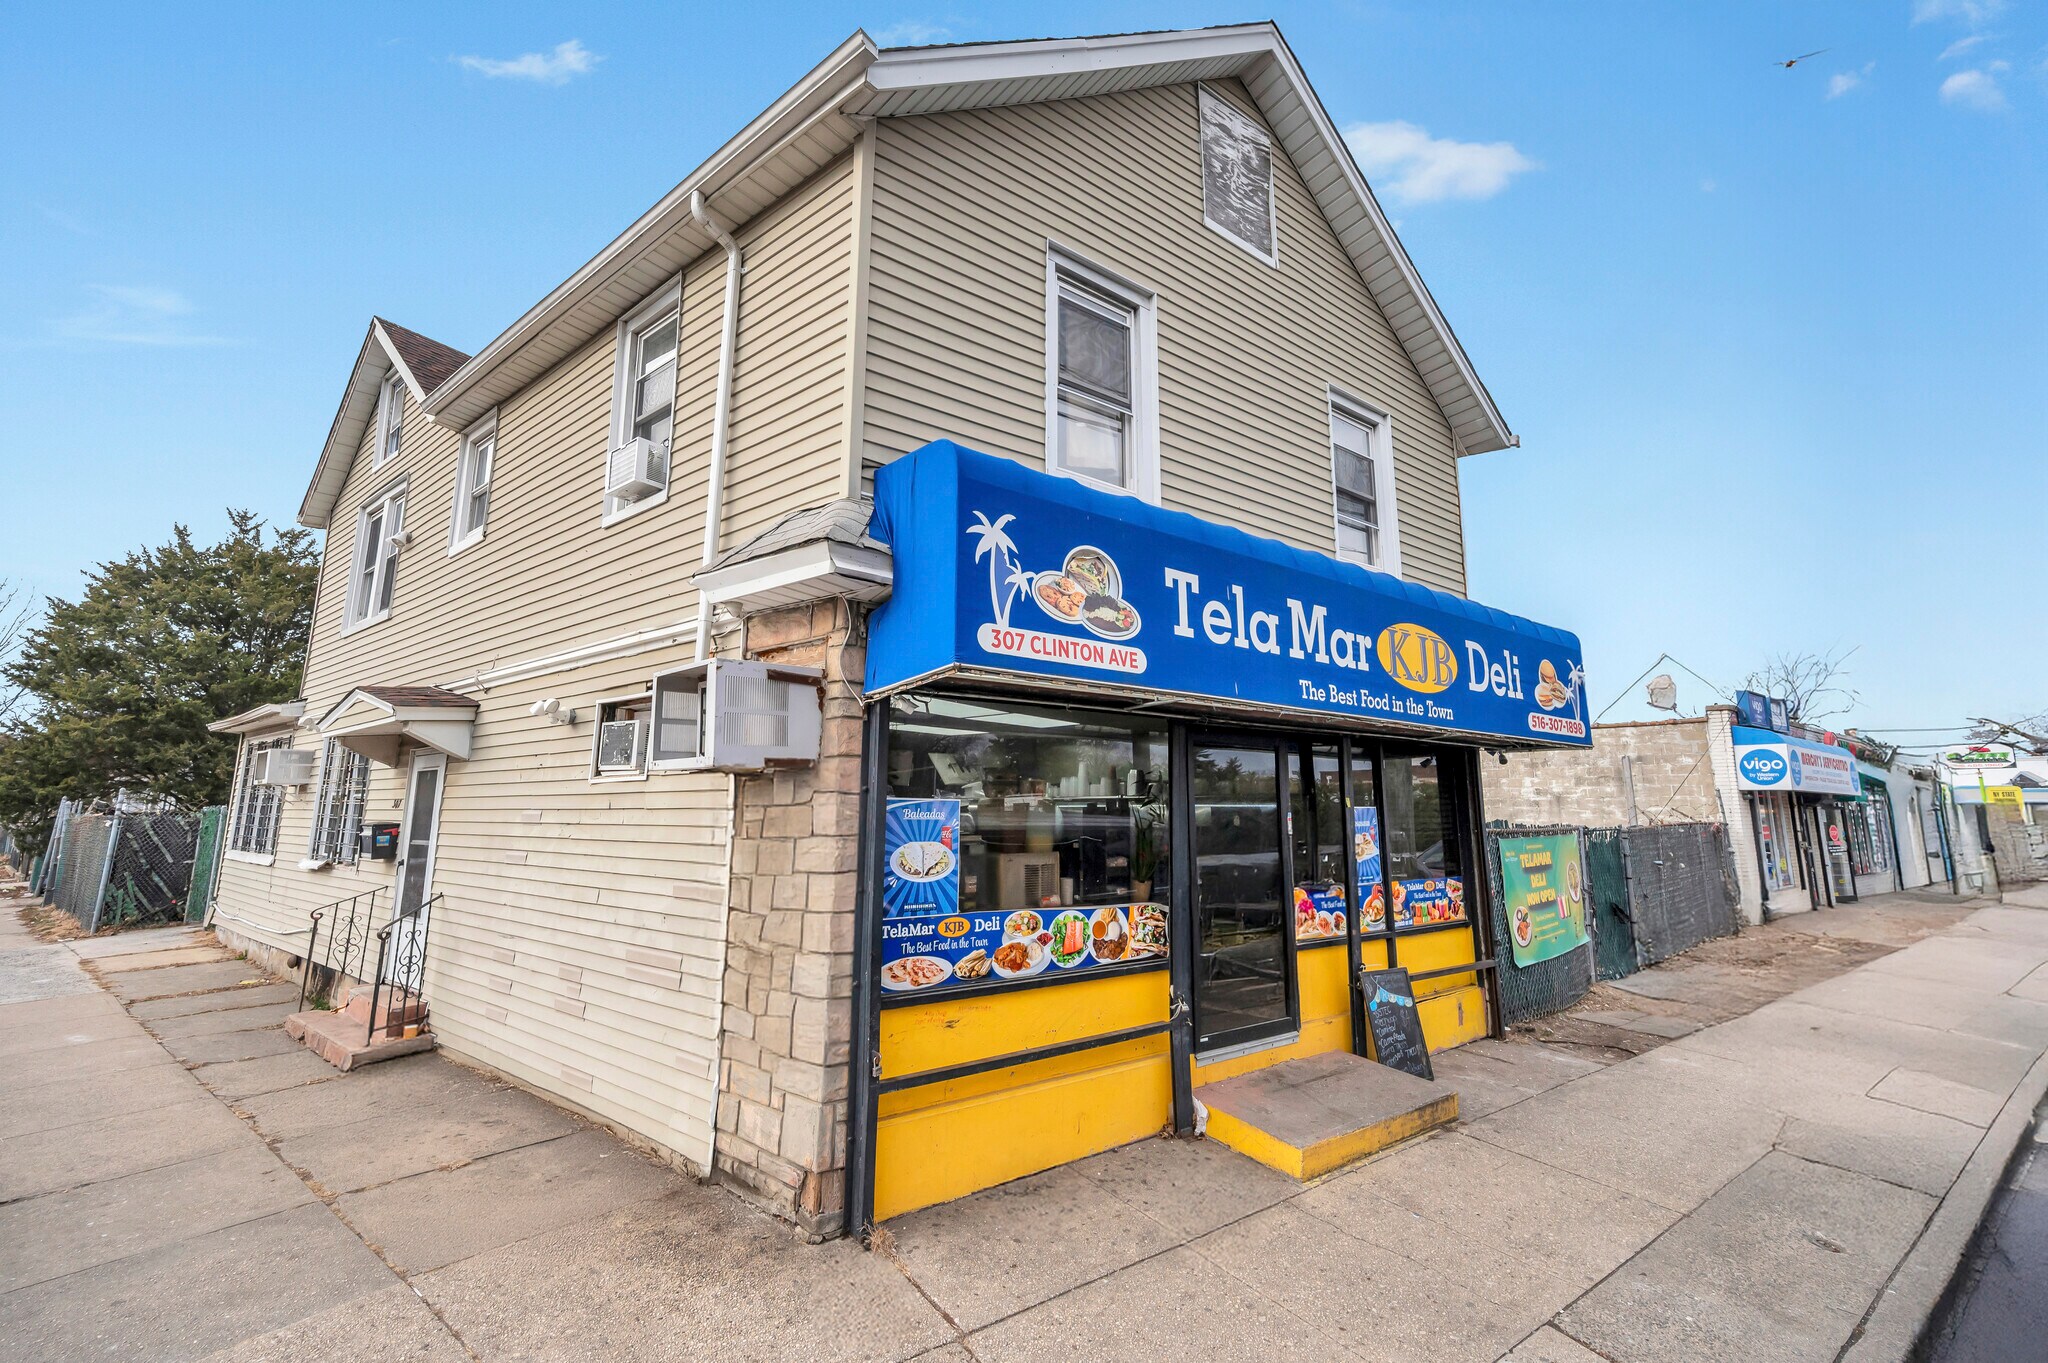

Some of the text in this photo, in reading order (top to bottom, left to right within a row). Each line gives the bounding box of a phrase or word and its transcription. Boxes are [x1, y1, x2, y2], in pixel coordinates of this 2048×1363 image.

[1165, 567, 1524, 699] Tela Mar KJB Deli
[991, 629, 1139, 669] 307 CLINTON AVE
[1299, 679, 1454, 720] The Best Food in the Town
[1531, 715, 1583, 735] 516-307-1898
[1743, 757, 1783, 772] vigo
[903, 808, 945, 820] Baleadas
[1520, 852, 1552, 868] TELAMAR
[1530, 873, 1546, 888] DELI
[882, 916, 1001, 939] TelaMar KJB Deli
[901, 936, 989, 955] The Best Food in the Town
